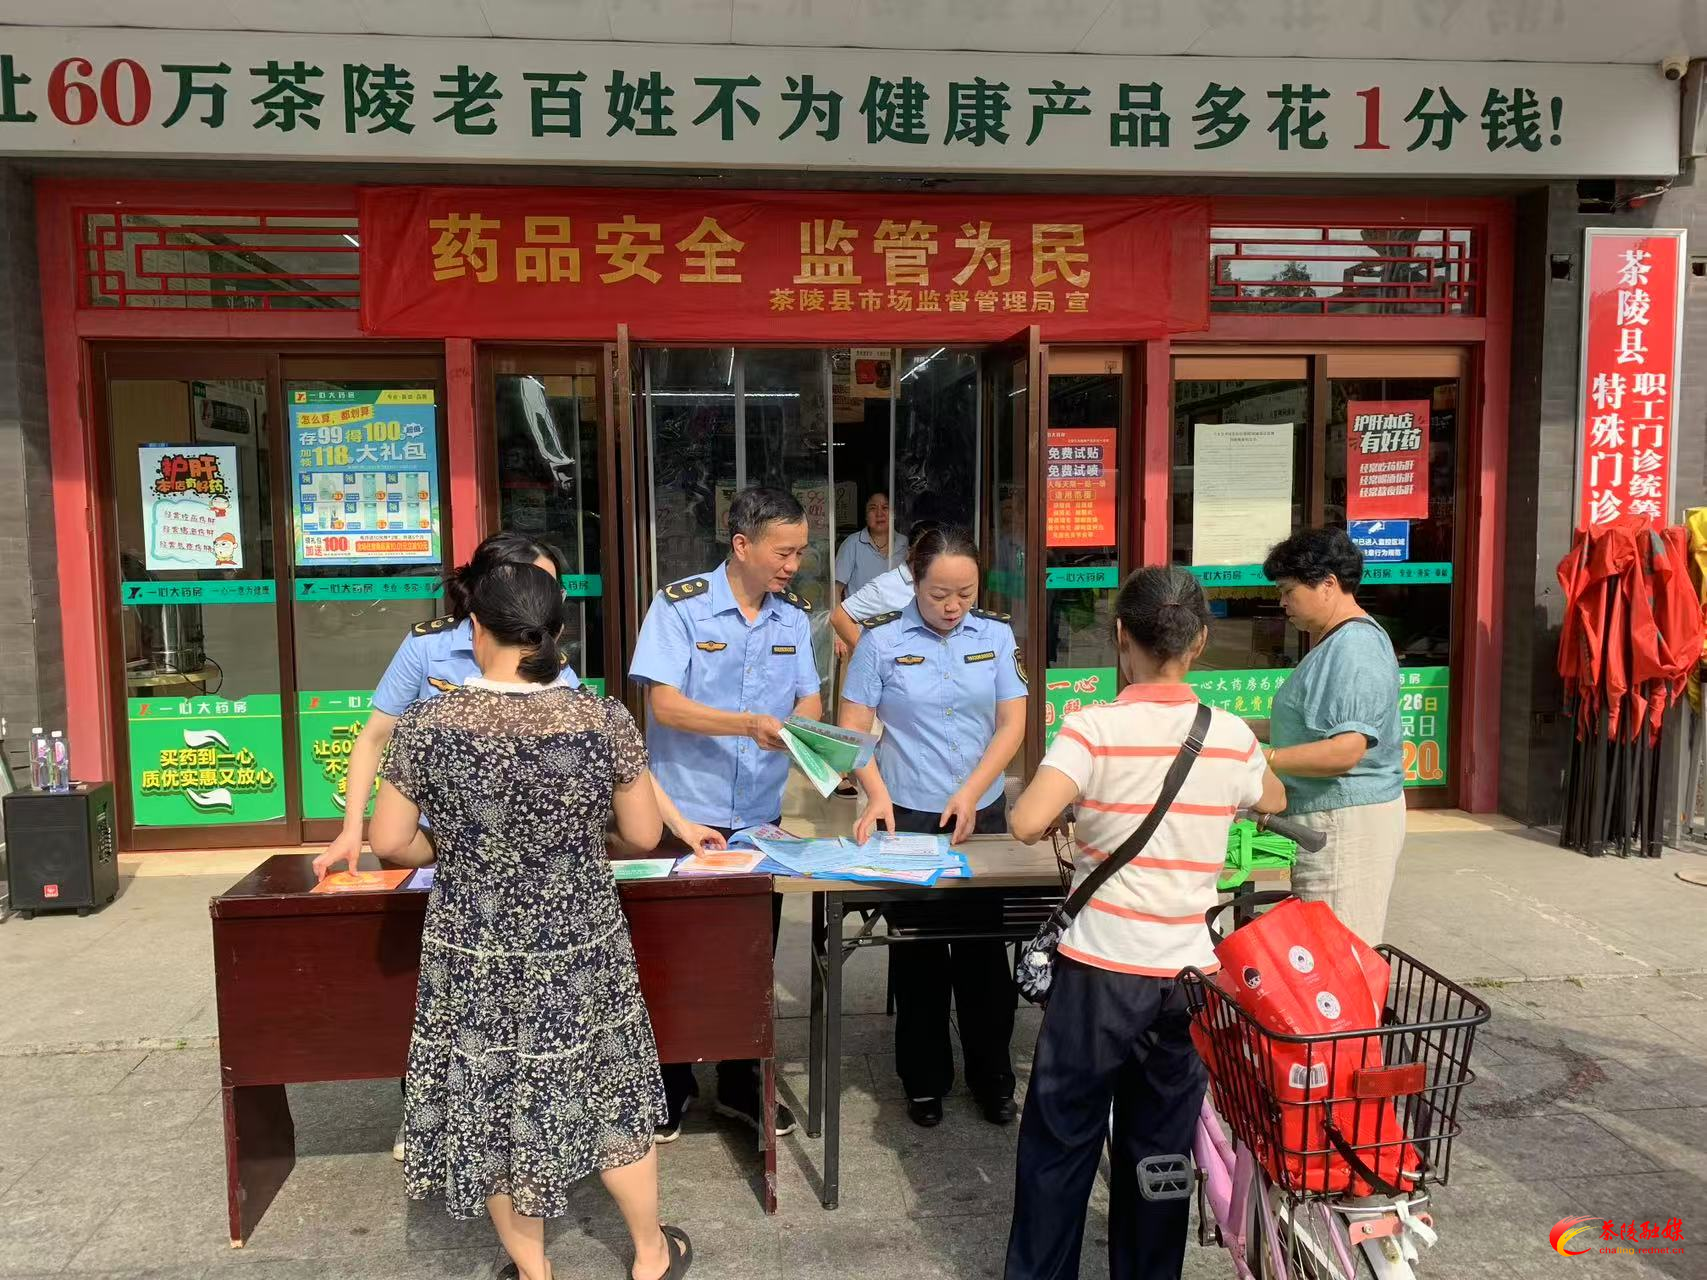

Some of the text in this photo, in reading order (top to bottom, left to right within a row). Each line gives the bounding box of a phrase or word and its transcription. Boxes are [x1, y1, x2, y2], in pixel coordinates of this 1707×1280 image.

[429, 212, 1091, 288] 药品安全 监管为民
[768, 288, 1090, 313] 茶陵县市场监督管理局 宣
[1614, 249, 1652, 365] 茶陵县
[1354, 412, 1414, 432] 护肝本店
[1360, 428, 1422, 454] 有好药
[1588, 372, 1628, 526] 特殊门诊
[1048, 447, 1099, 460] 免费试贴
[1048, 464, 1099, 477] 免费试喷
[1047, 675, 1100, 693] 一心
[160, 747, 254, 768] 买药到一心
[141, 767, 275, 789] 质优实惠又放心
